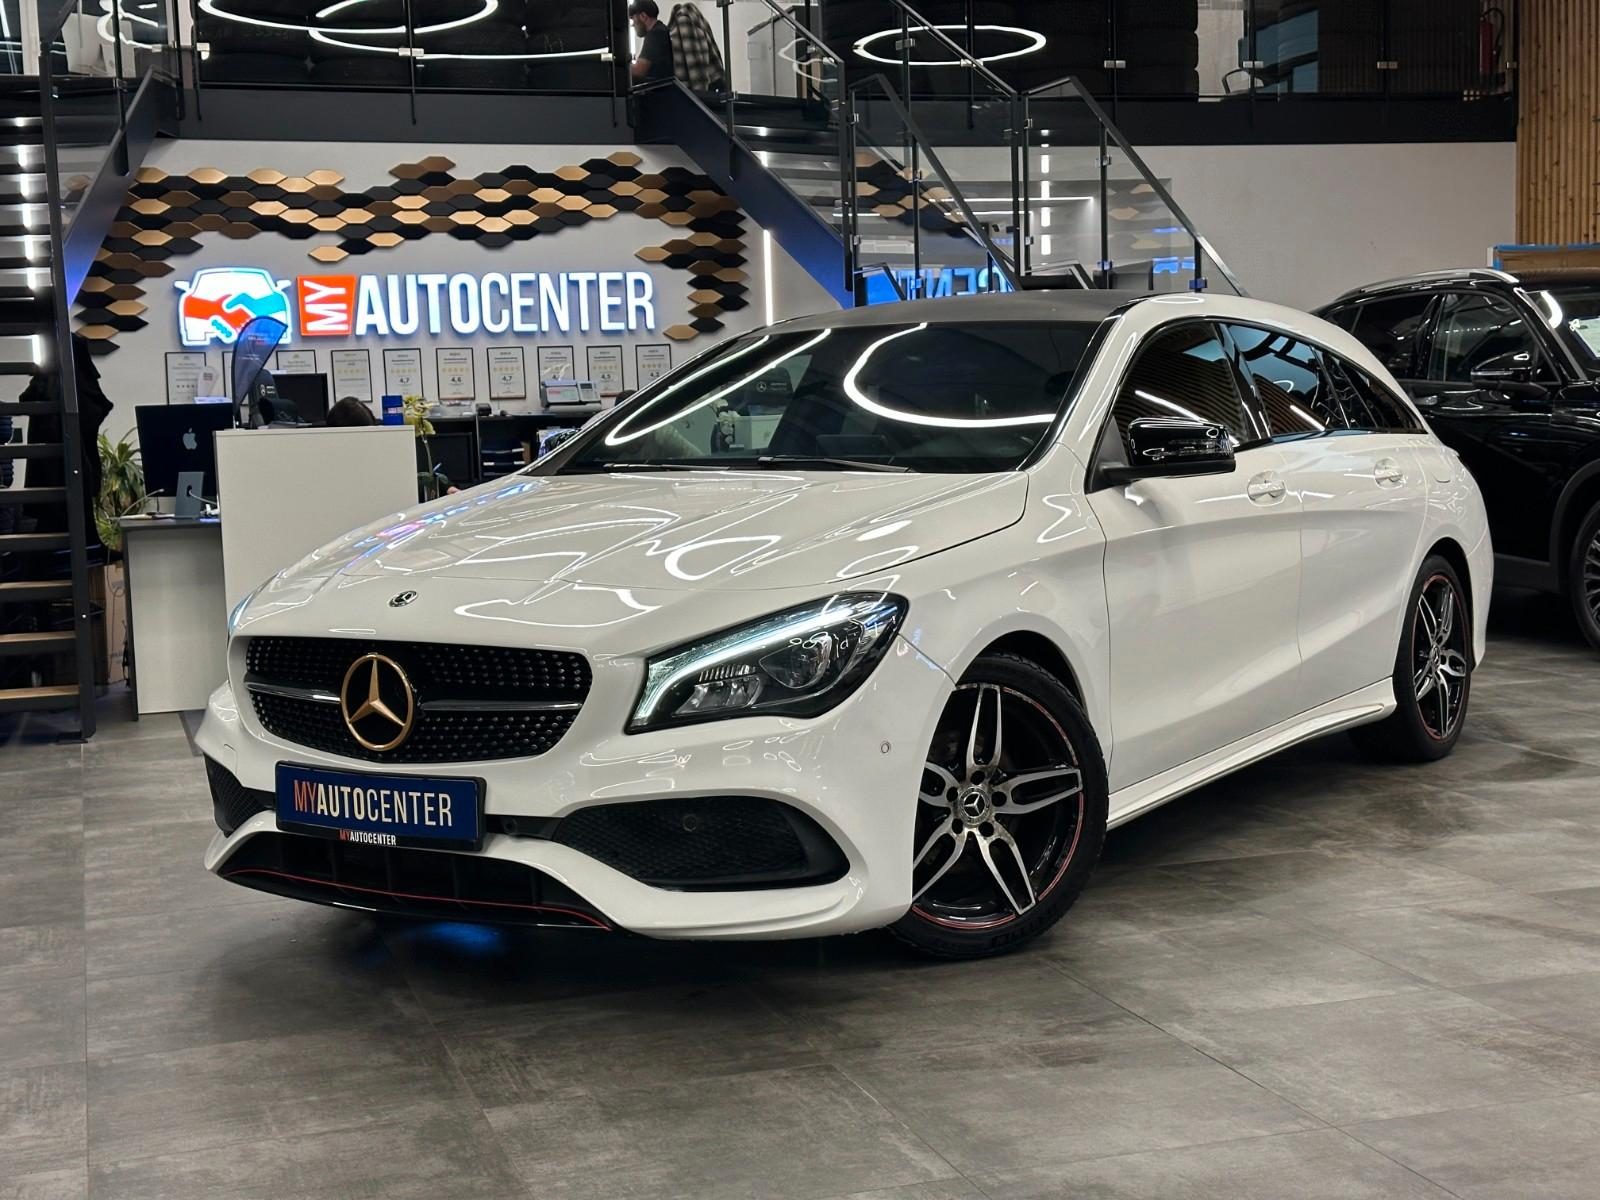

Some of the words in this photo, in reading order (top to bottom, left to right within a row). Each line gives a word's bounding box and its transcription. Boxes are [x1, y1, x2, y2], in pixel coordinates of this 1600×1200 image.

[304, 280, 349, 332] MY
[355, 272, 655, 336] AUTOCENTER
[294, 779, 453, 827] MYAUTOCENTER
[339, 829, 397, 847] MYAUTOCENTER
